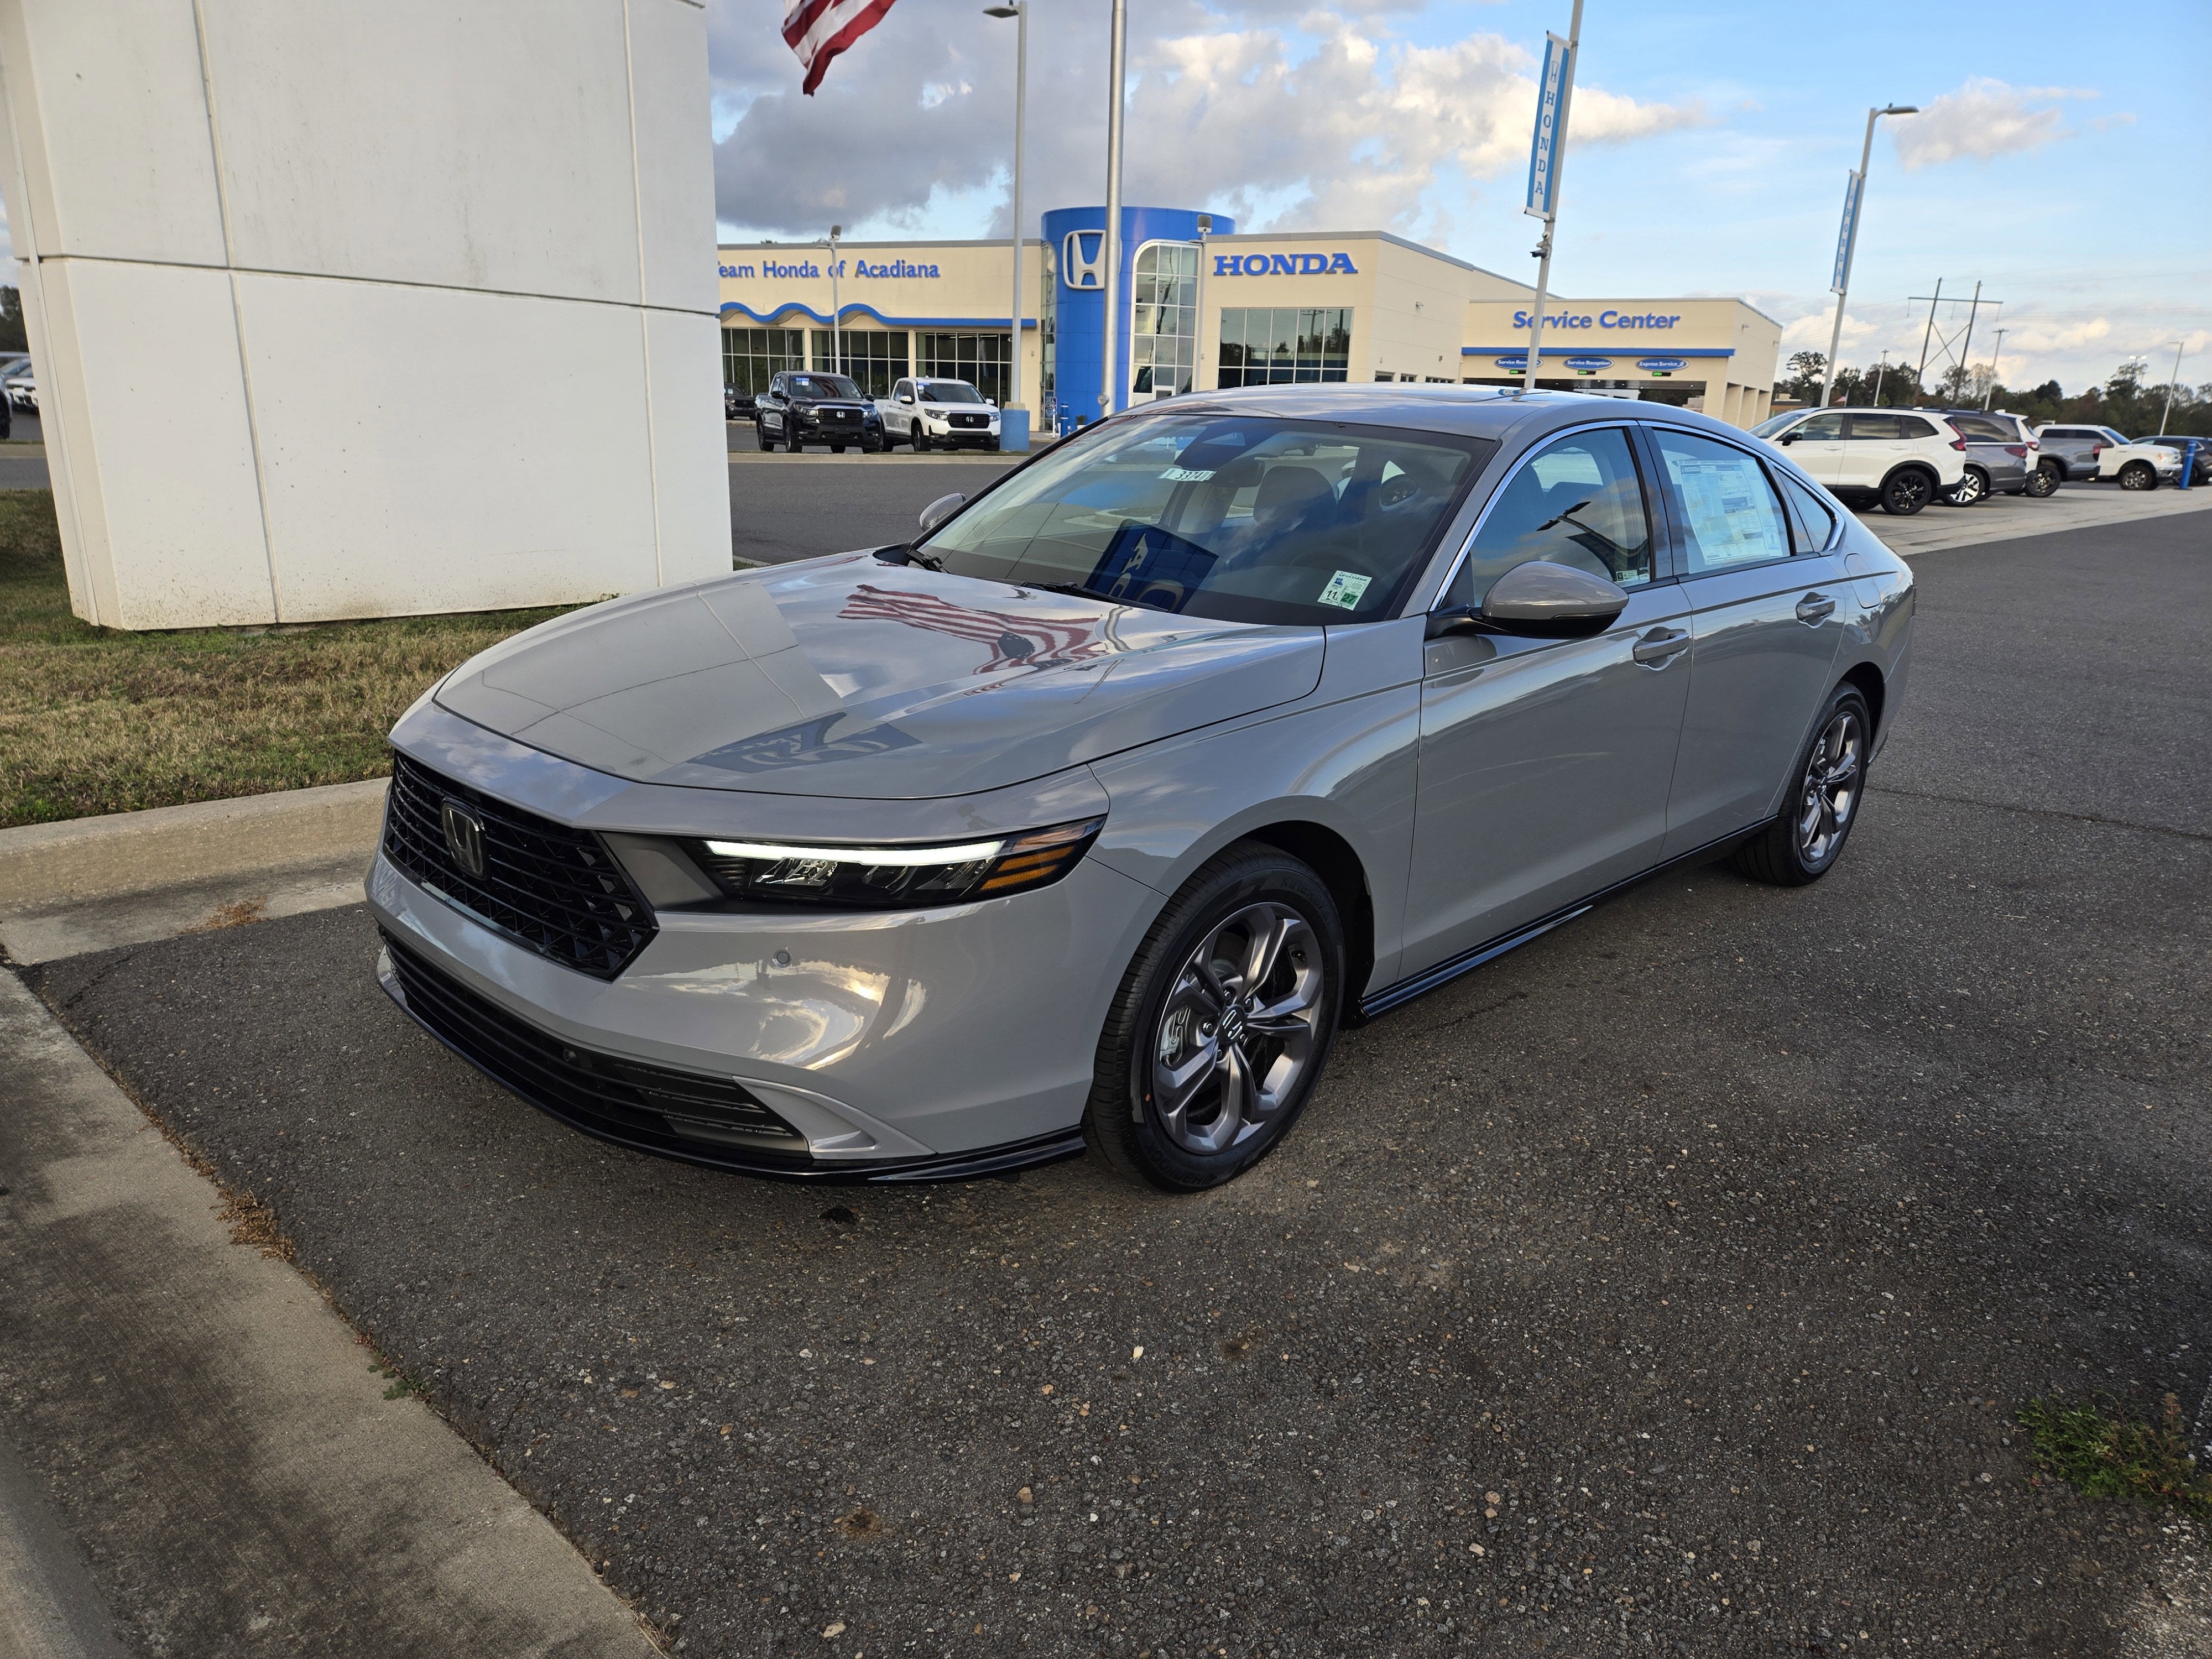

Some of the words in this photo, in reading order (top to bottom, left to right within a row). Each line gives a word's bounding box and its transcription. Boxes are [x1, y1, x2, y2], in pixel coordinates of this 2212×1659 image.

[1535, 91, 1556, 195] HONDA
[718, 260, 755, 278] eam
[763, 260, 820, 278] Honda
[854, 259, 941, 278] Acadiana
[1213, 253, 1358, 276] HONDA
[1599, 310, 1681, 328] Center
[1175, 471, 1205, 481] 3374
[1327, 590, 1338, 599] 11
[1342, 594, 1357, 604] 27
